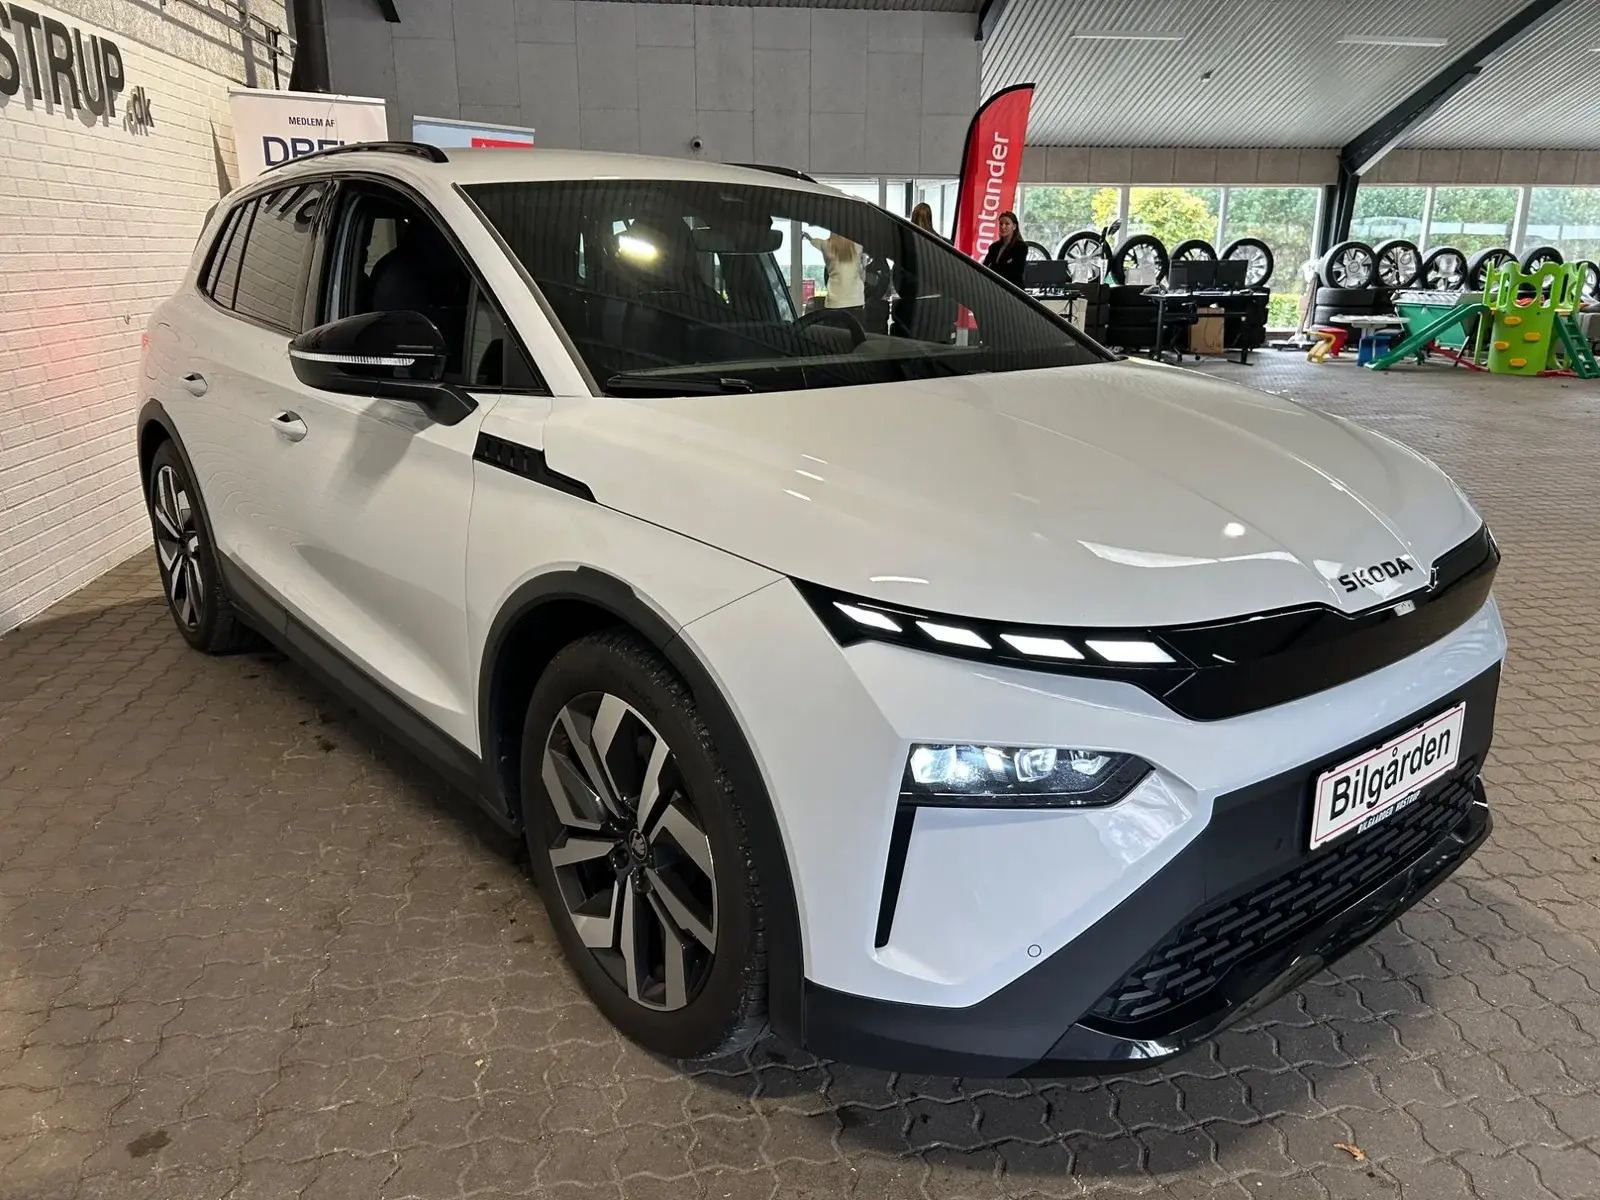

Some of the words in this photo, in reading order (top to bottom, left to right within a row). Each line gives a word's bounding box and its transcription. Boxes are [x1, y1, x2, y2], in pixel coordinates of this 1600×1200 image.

[288, 116, 323, 127] MEDLEM
[325, 119, 335, 128] AF
[1329, 729, 1451, 821] Bilgården
